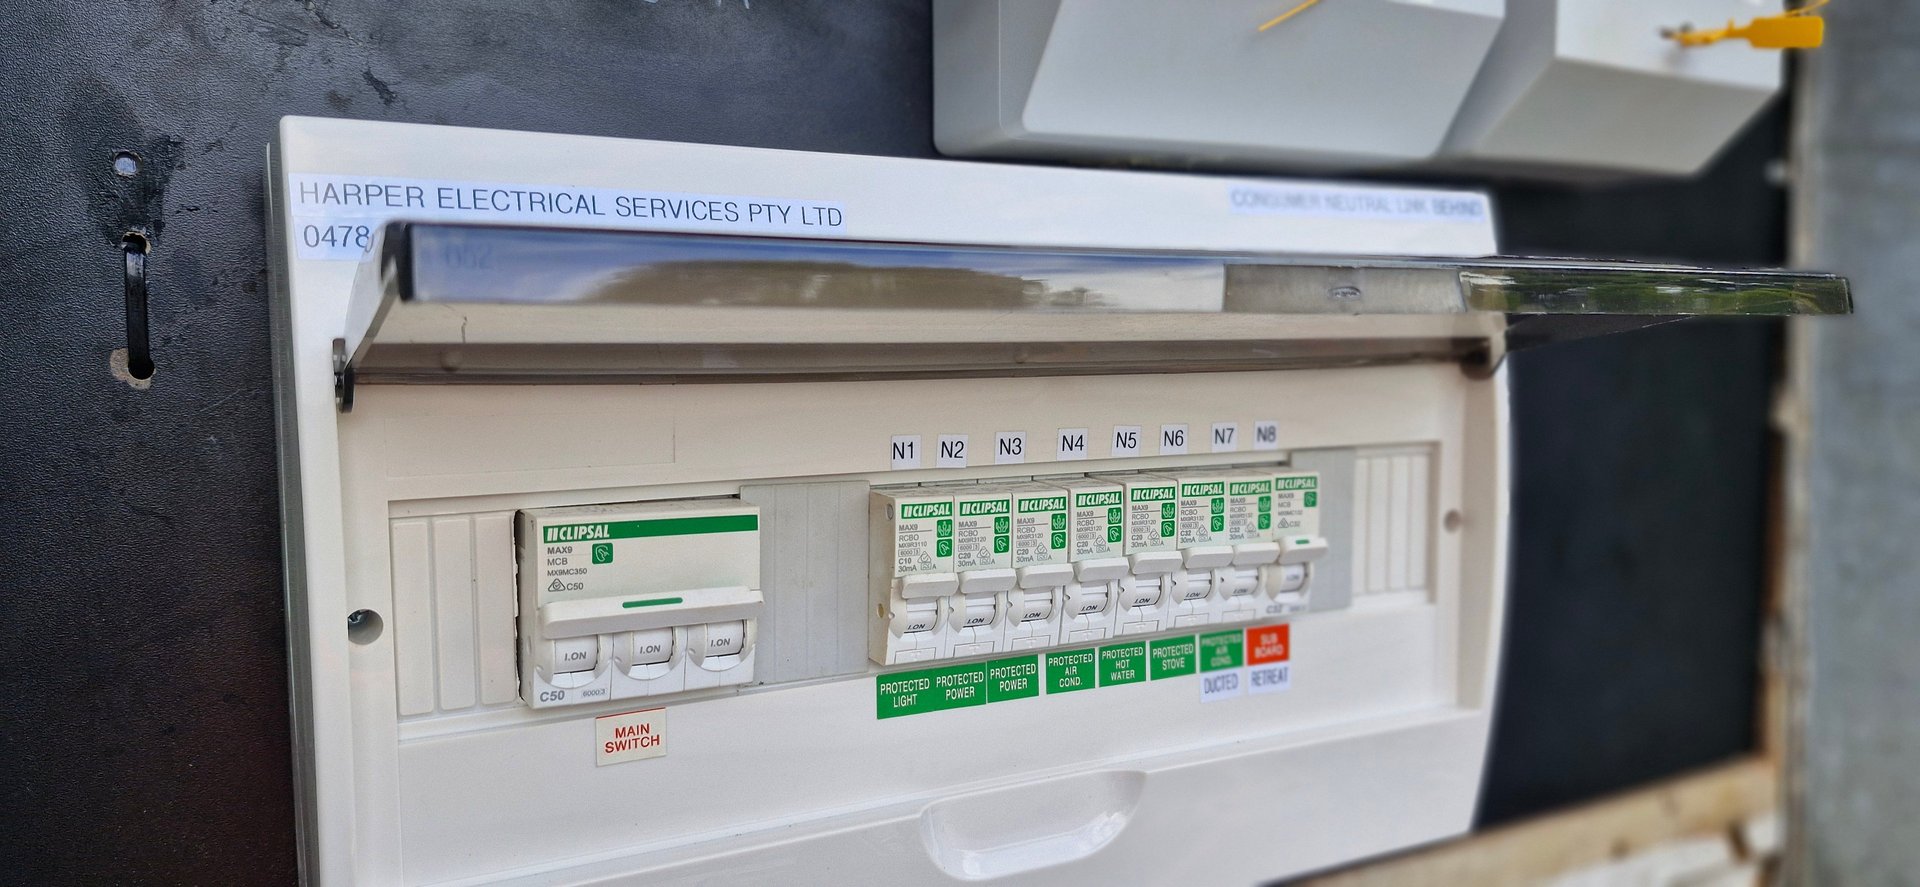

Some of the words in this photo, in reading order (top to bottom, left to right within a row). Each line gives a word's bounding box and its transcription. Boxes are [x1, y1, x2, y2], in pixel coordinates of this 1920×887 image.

[300, 181, 425, 207] HARPER
[437, 187, 605, 216] ELECTRICAL
[616, 196, 739, 222] SERVICES
[749, 203, 791, 224] PTY
[802, 206, 842, 227] LTD
[1116, 431, 1137, 449] N5
[1163, 429, 1184, 447] N6
[1214, 427, 1235, 444] N7
[1256, 425, 1276, 442] N8
[941, 440, 964, 459] N2
[999, 437, 1022, 455] N3
[1061, 434, 1084, 452] N4
[892, 441, 915, 460] N1
[1192, 483, 1223, 495] CLIPSAL
[1240, 482, 1270, 493] CLIPSAL
[1285, 478, 1316, 490] CLIPSAL
[1086, 493, 1120, 506] CLIPSAL
[1141, 488, 1174, 500] CLIPSAL
[913, 503, 950, 517] CLIPSAL
[971, 501, 1008, 514] CLIPSAL
[1029, 498, 1064, 511] CLIPSAL
[559, 525, 610, 540] CLIPSAL
[547, 546, 573, 555] MAX9
[547, 557, 568, 566] MCB
[899, 557, 911, 565] C10
[1016, 555, 1034, 563] 30mA
[898, 565, 917, 573] 30mA
[566, 582, 584, 591] C50
[1201, 633, 1242, 646] PROTECTED
[1260, 633, 1278, 645] SUB
[1102, 646, 1144, 660] PROTECTED
[1152, 643, 1194, 659] PROTECTED
[1254, 644, 1284, 659] BOARD
[1048, 653, 1093, 667] PROTECTED
[1115, 659, 1130, 670] HOT
[1162, 657, 1185, 671] STOVE
[990, 663, 1036, 680] PROTECTED
[1065, 665, 1077, 676] AIR
[1111, 669, 1135, 681] WATER
[1251, 667, 1289, 687] RETREAT
[880, 678, 930, 695] PROTECTED
[936, 671, 984, 688] PROTECTED
[999, 678, 1028, 693] POWER
[1059, 677, 1083, 688] COND.
[1204, 674, 1239, 694] DUCTED
[540, 689, 565, 702] C50
[945, 686, 975, 700] POWER
[893, 694, 917, 708] LIGHT
[615, 723, 650, 739] MAIN
[604, 734, 661, 754] SWITCH
